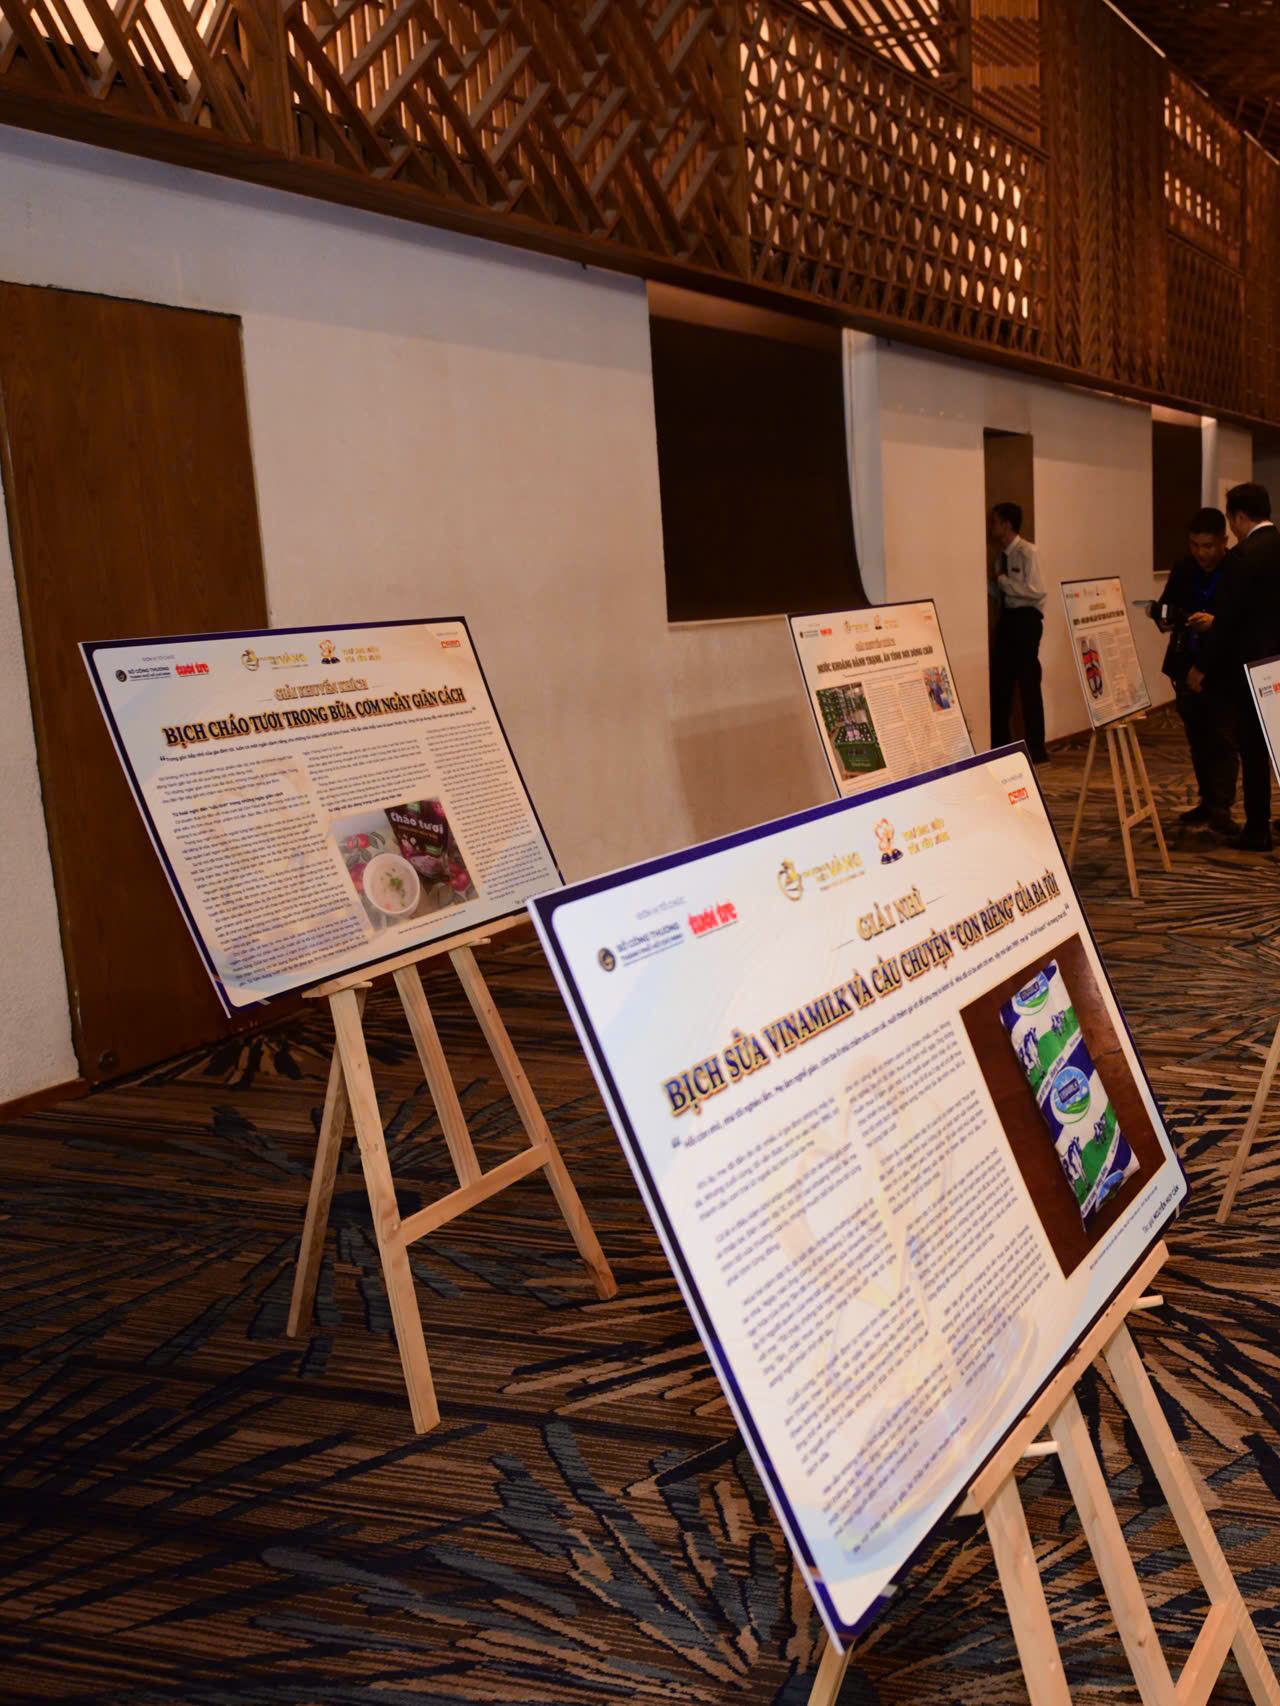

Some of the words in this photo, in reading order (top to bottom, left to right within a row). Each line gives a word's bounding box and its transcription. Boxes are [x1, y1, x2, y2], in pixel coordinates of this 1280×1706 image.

[162, 722, 209, 749] BỊCH
[208, 713, 251, 740] CHÁO
[249, 710, 285, 734] TƯƠI
[283, 704, 331, 729] TRONG
[328, 700, 357, 723] BỮA
[355, 697, 382, 718] CƠM
[381, 691, 413, 714] NGÀY
[411, 688, 440, 710] GIÃN
[437, 685, 467, 706] CÁCH
[856, 900, 896, 941] GIẢI
[891, 884, 926, 924] NHÌ
[661, 1053, 729, 1118] BỊCH
[722, 1027, 770, 1083] SỮA
[760, 987, 855, 1059] VINAMILK
[846, 968, 876, 1010] VÀ
[869, 953, 904, 998] CÂU
[899, 927, 954, 981] CHUYỆN
[1013, 879, 1038, 916] CỦA
[1030, 879, 1047, 908] BA
[1041, 868, 1062, 903] TÔI
